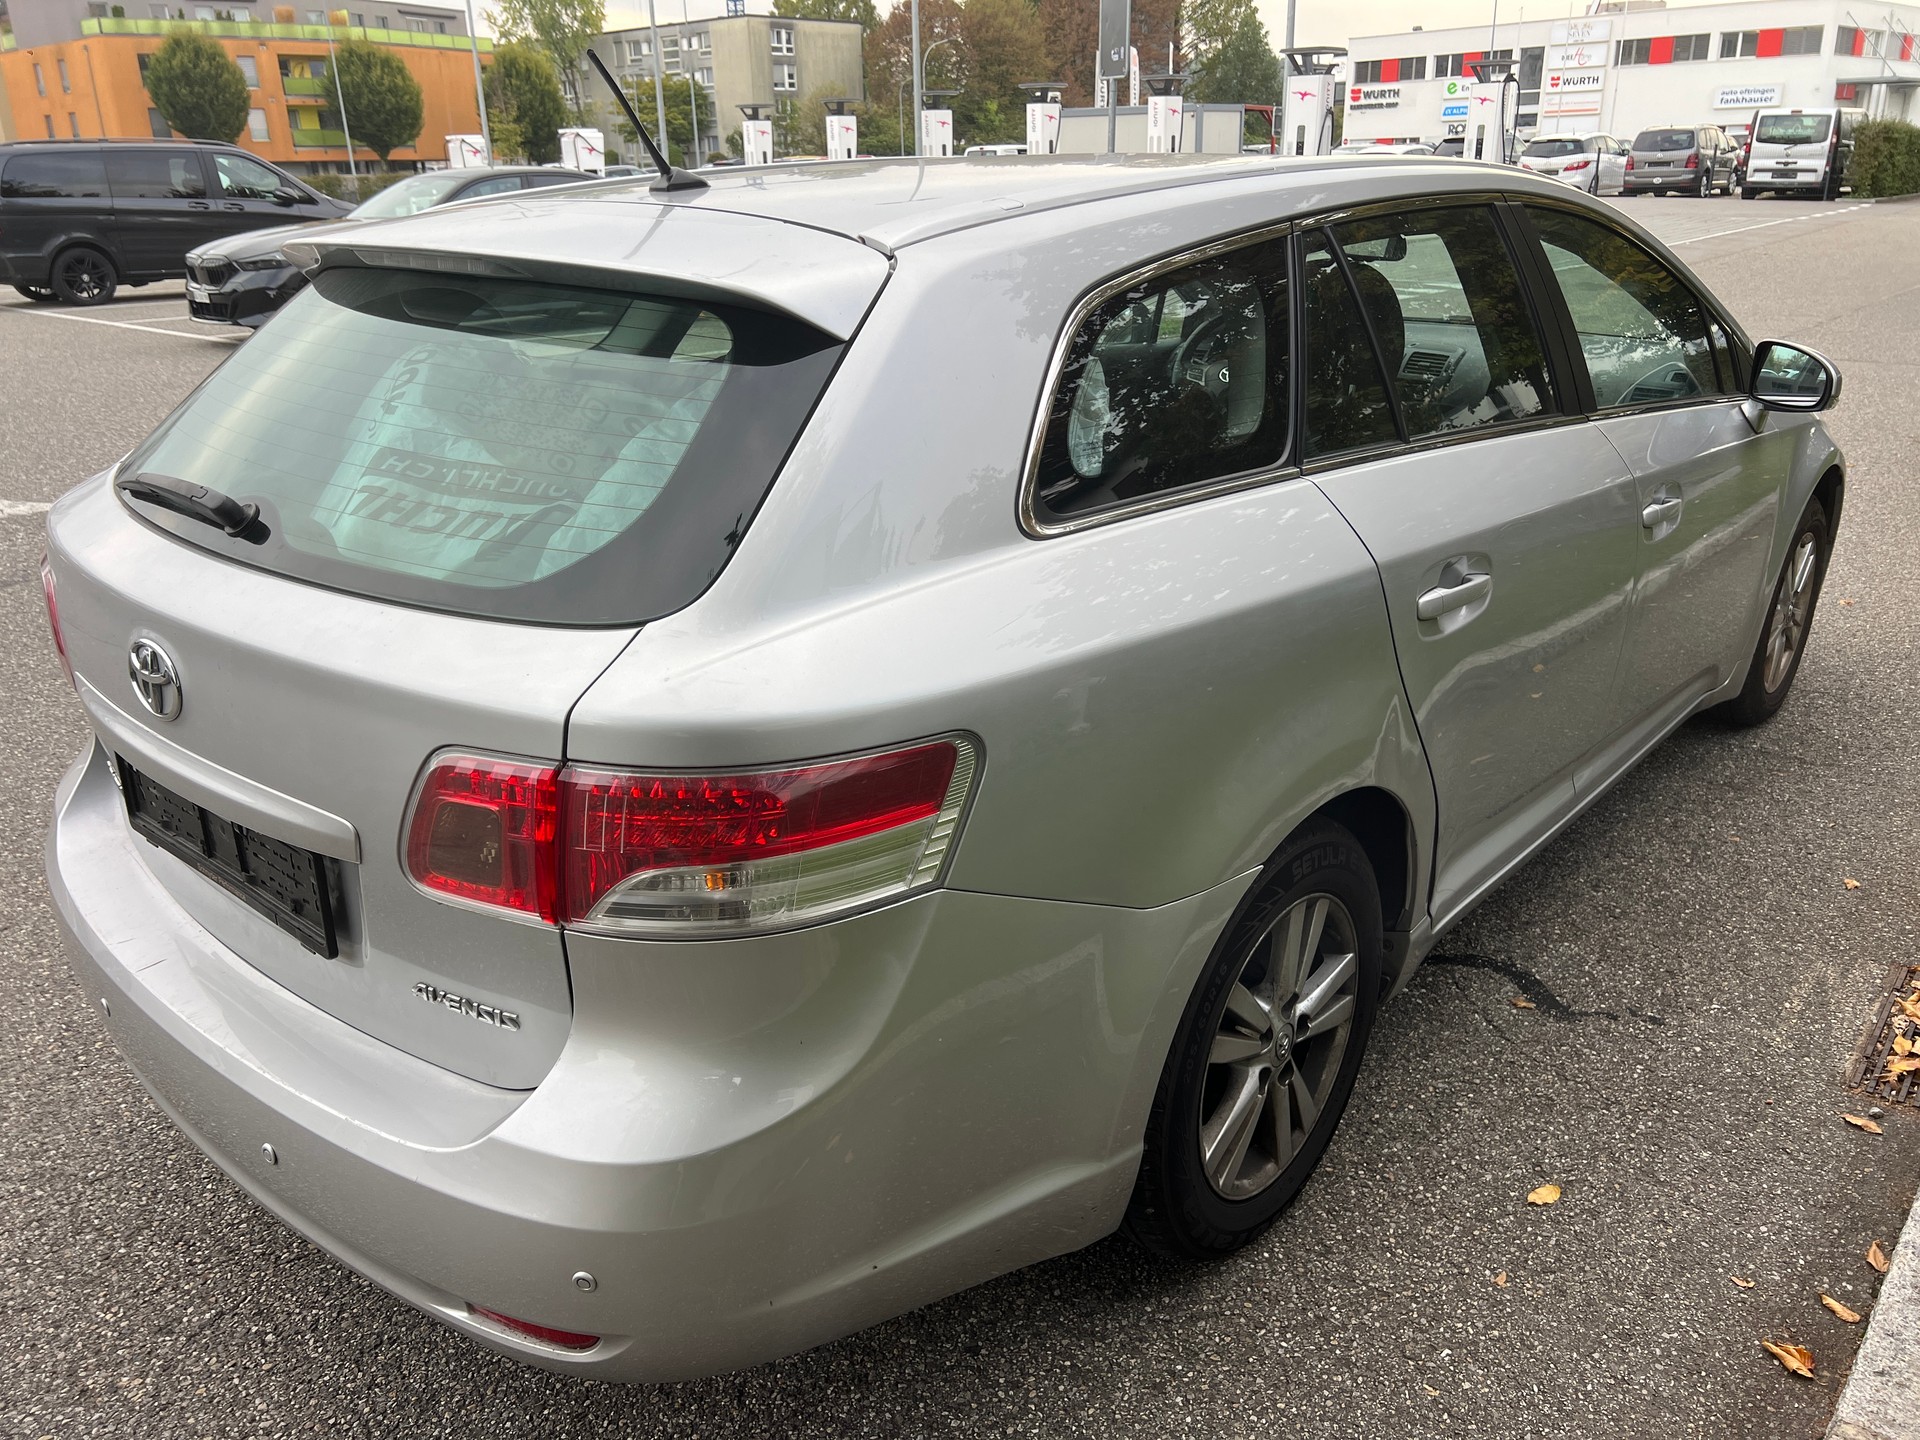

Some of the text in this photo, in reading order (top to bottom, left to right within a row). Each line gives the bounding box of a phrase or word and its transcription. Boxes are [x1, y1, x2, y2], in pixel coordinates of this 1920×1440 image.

[1562, 76, 1599, 86] WÜRTH
[1363, 88, 1400, 100] WÜRTH
[1739, 87, 1775, 95] oftringen
[1720, 96, 1774, 105] fankhauser
[411, 982, 520, 1032] AVENSIS
